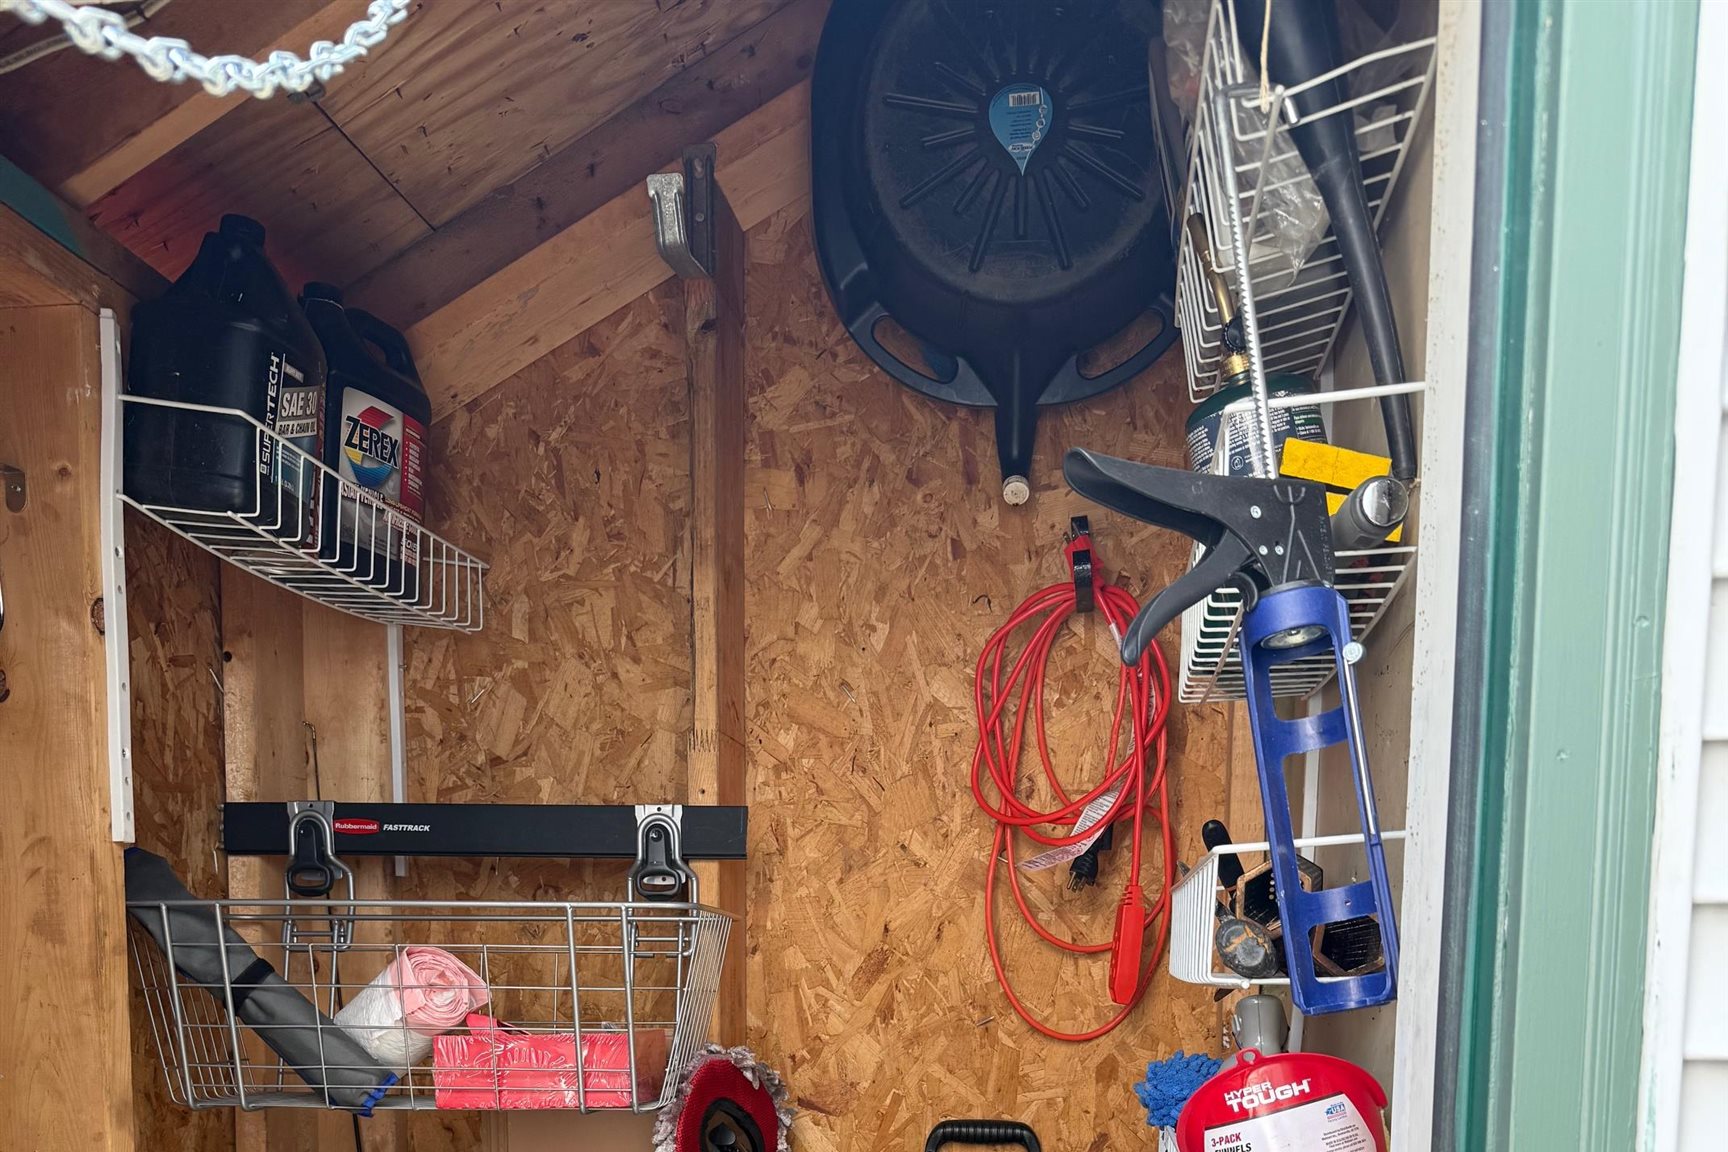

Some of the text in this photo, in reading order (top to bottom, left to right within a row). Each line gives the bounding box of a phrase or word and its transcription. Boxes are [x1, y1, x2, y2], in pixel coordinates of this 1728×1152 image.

[281, 391, 318, 418] SAE 30
[344, 415, 399, 470] ZEREX
[383, 824, 431, 832] FASTTRACK
[1224, 1081, 1273, 1101] HYPER
[1226, 1079, 1311, 1113] TOUGH
[1211, 1132, 1242, 1147] 3-PACK
